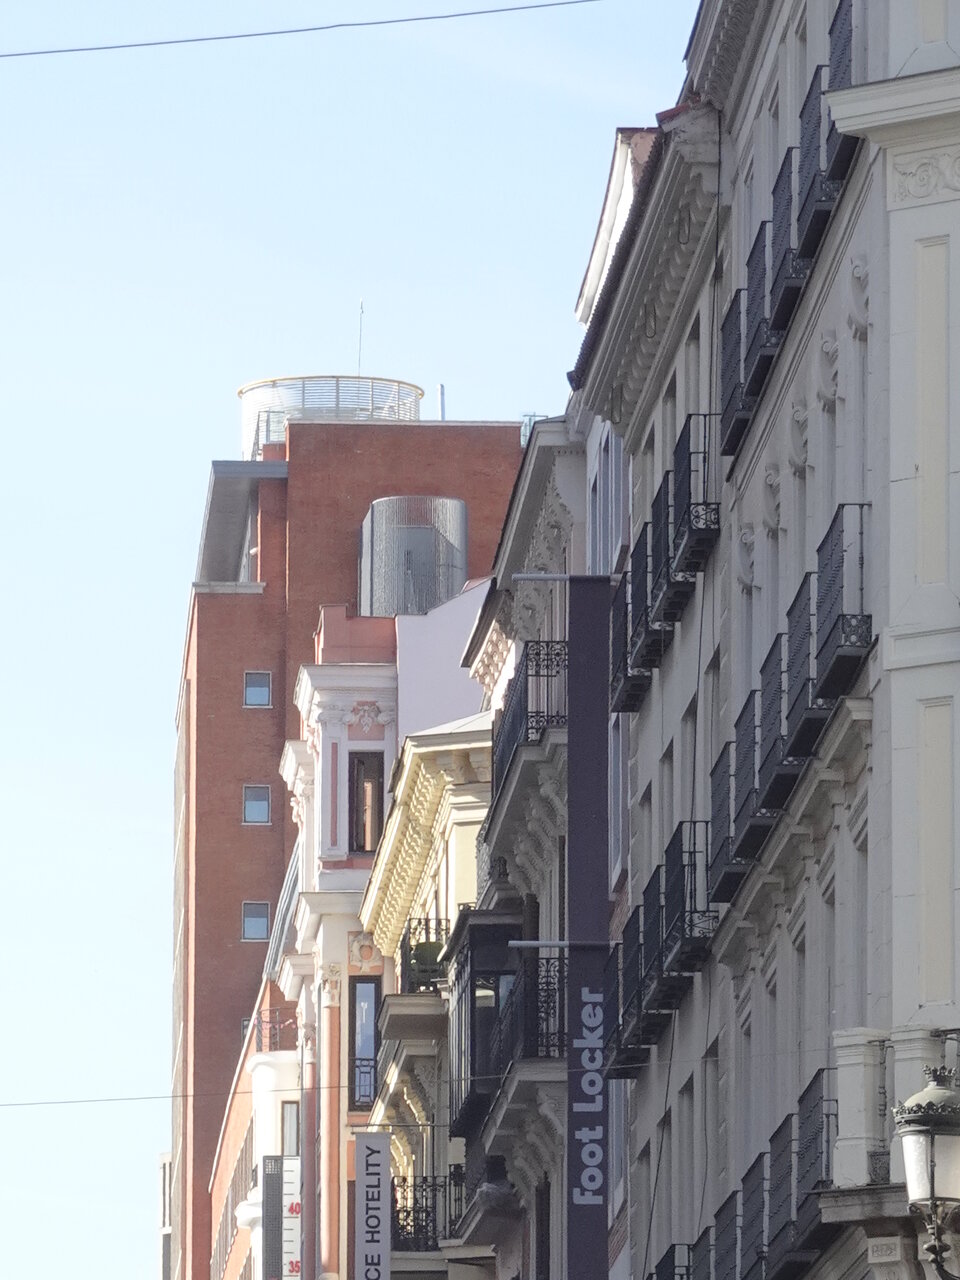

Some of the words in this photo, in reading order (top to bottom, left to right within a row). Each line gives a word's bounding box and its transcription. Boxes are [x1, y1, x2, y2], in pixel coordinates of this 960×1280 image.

[573, 987, 604, 1112] Locker
[363, 1145, 382, 1243] HOTELITY
[573, 1126, 604, 1205] Foot
[288, 1202, 301, 1215] 40
[288, 1260, 301, 1274] 35
